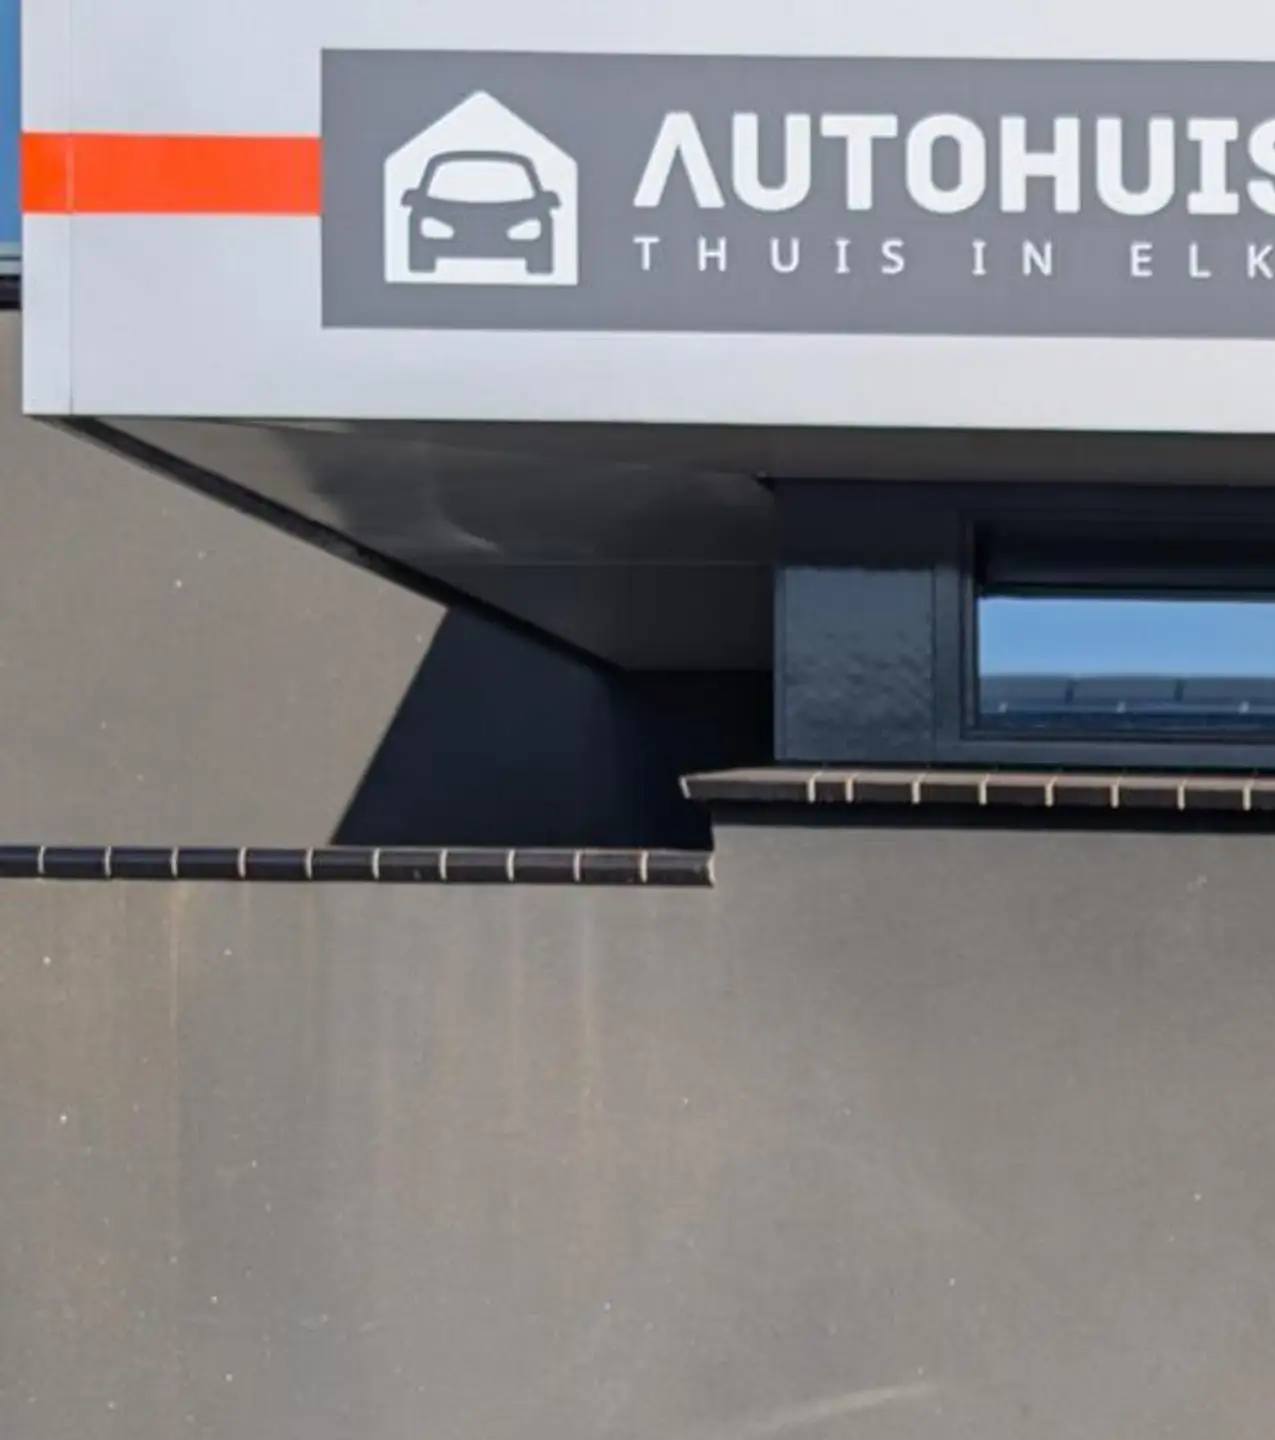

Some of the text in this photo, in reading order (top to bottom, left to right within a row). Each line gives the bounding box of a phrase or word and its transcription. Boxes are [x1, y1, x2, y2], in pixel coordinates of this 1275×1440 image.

[632, 235, 906, 276] THUIS
[971, 239, 1054, 277] IN
[1129, 241, 1274, 280] ELK
